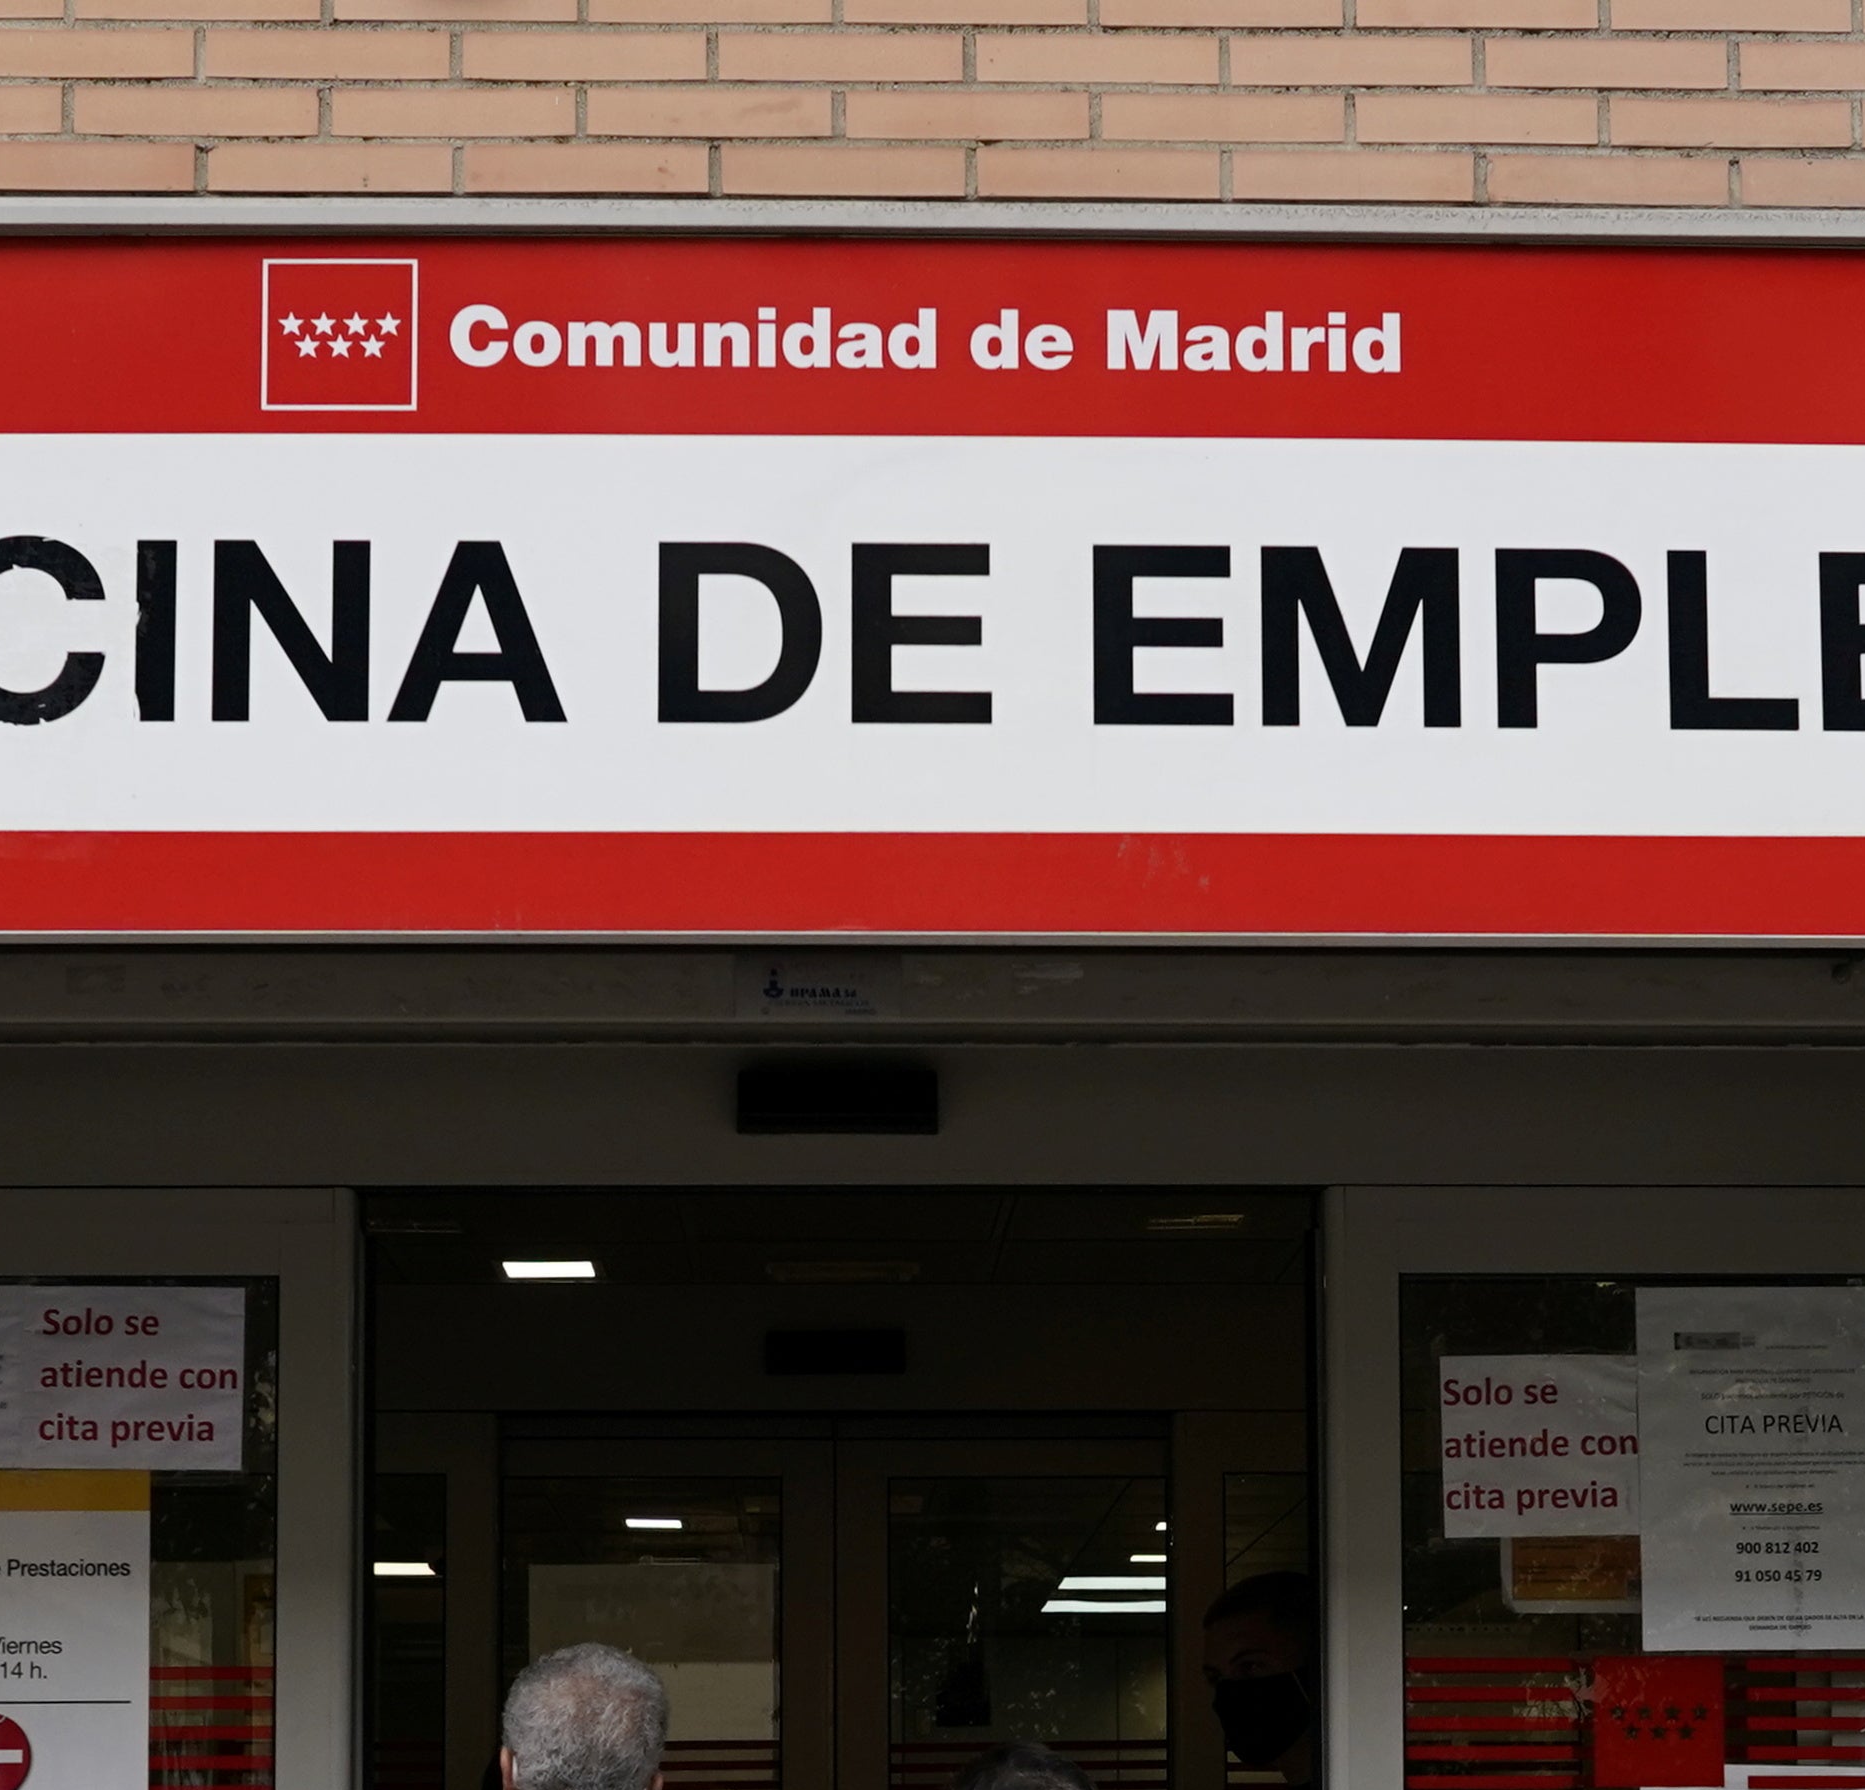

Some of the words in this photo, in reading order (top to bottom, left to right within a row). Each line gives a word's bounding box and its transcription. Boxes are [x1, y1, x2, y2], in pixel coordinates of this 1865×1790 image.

[450, 305, 936, 369] Comunidad
[970, 309, 1073, 370] de
[1107, 310, 1400, 373] Madrid
[658, 542, 992, 724] DE
[43, 1308, 113, 1335] Solo
[125, 1316, 159, 1336] se
[41, 1360, 167, 1388] atiende
[180, 1369, 237, 1389] con
[1444, 1377, 1512, 1405] Solo
[1524, 1384, 1558, 1404] se
[39, 1413, 98, 1441] cita
[112, 1414, 214, 1448] previa
[1705, 1416, 1755, 1434] CITA
[1764, 1414, 1843, 1433] PREVIA
[1445, 1429, 1568, 1458] atiende
[1581, 1434, 1639, 1455] con
[1446, 1482, 1504, 1510] cita
[1517, 1481, 1617, 1515] previa
[1730, 1503, 1823, 1515] www.sepe.es
[1736, 1542, 1761, 1554] 900
[1765, 1542, 1790, 1554] 812
[1794, 1542, 1819, 1553] 402
[8, 1559, 130, 1576] Prestaciones
[1735, 1570, 1751, 1582] 91
[1755, 1570, 1781, 1582] 050
[1785, 1570, 1802, 1582] 45
[1806, 1570, 1822, 1581] 79
[0, 1662, 23, 1678] 14
[30, 1661, 47, 1679] h.
